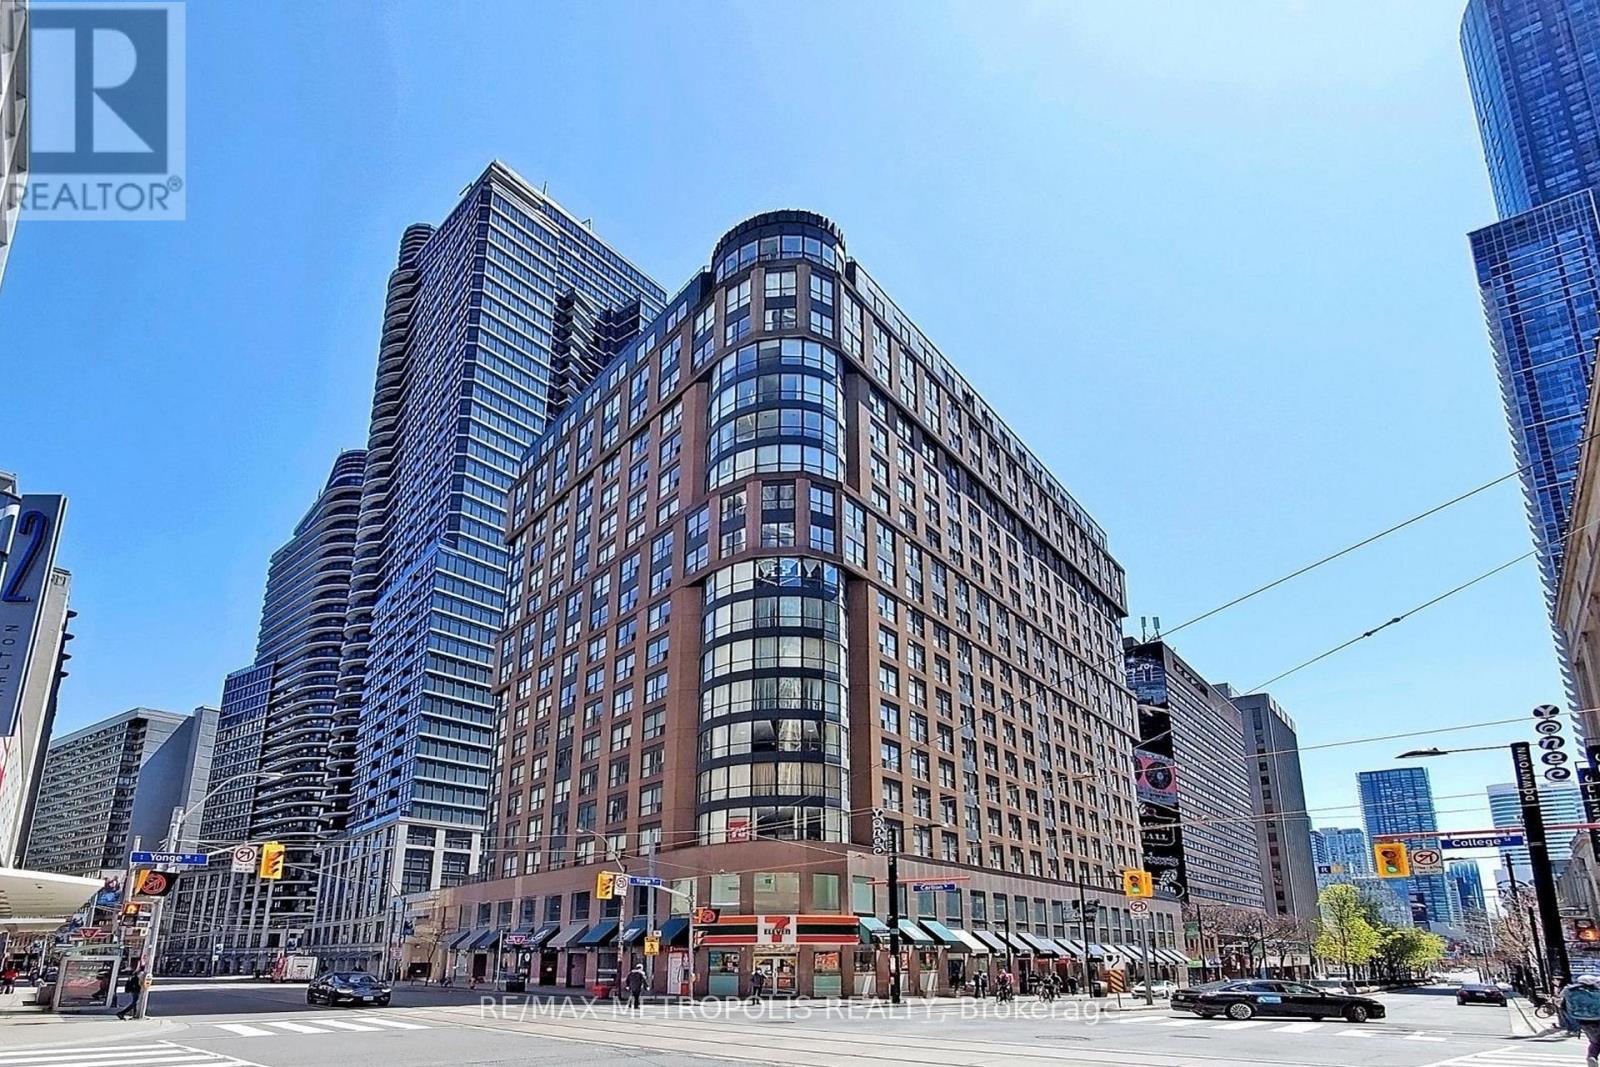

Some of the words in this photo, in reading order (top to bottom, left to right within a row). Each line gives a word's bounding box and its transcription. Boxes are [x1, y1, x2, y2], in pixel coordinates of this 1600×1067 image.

[2, 510, 48, 602] 2
[1517, 747, 1535, 801] DOWNTOWN
[1452, 838, 1501, 848] College
[150, 854, 182, 862] Yonge
[765, 916, 790, 942] 7
